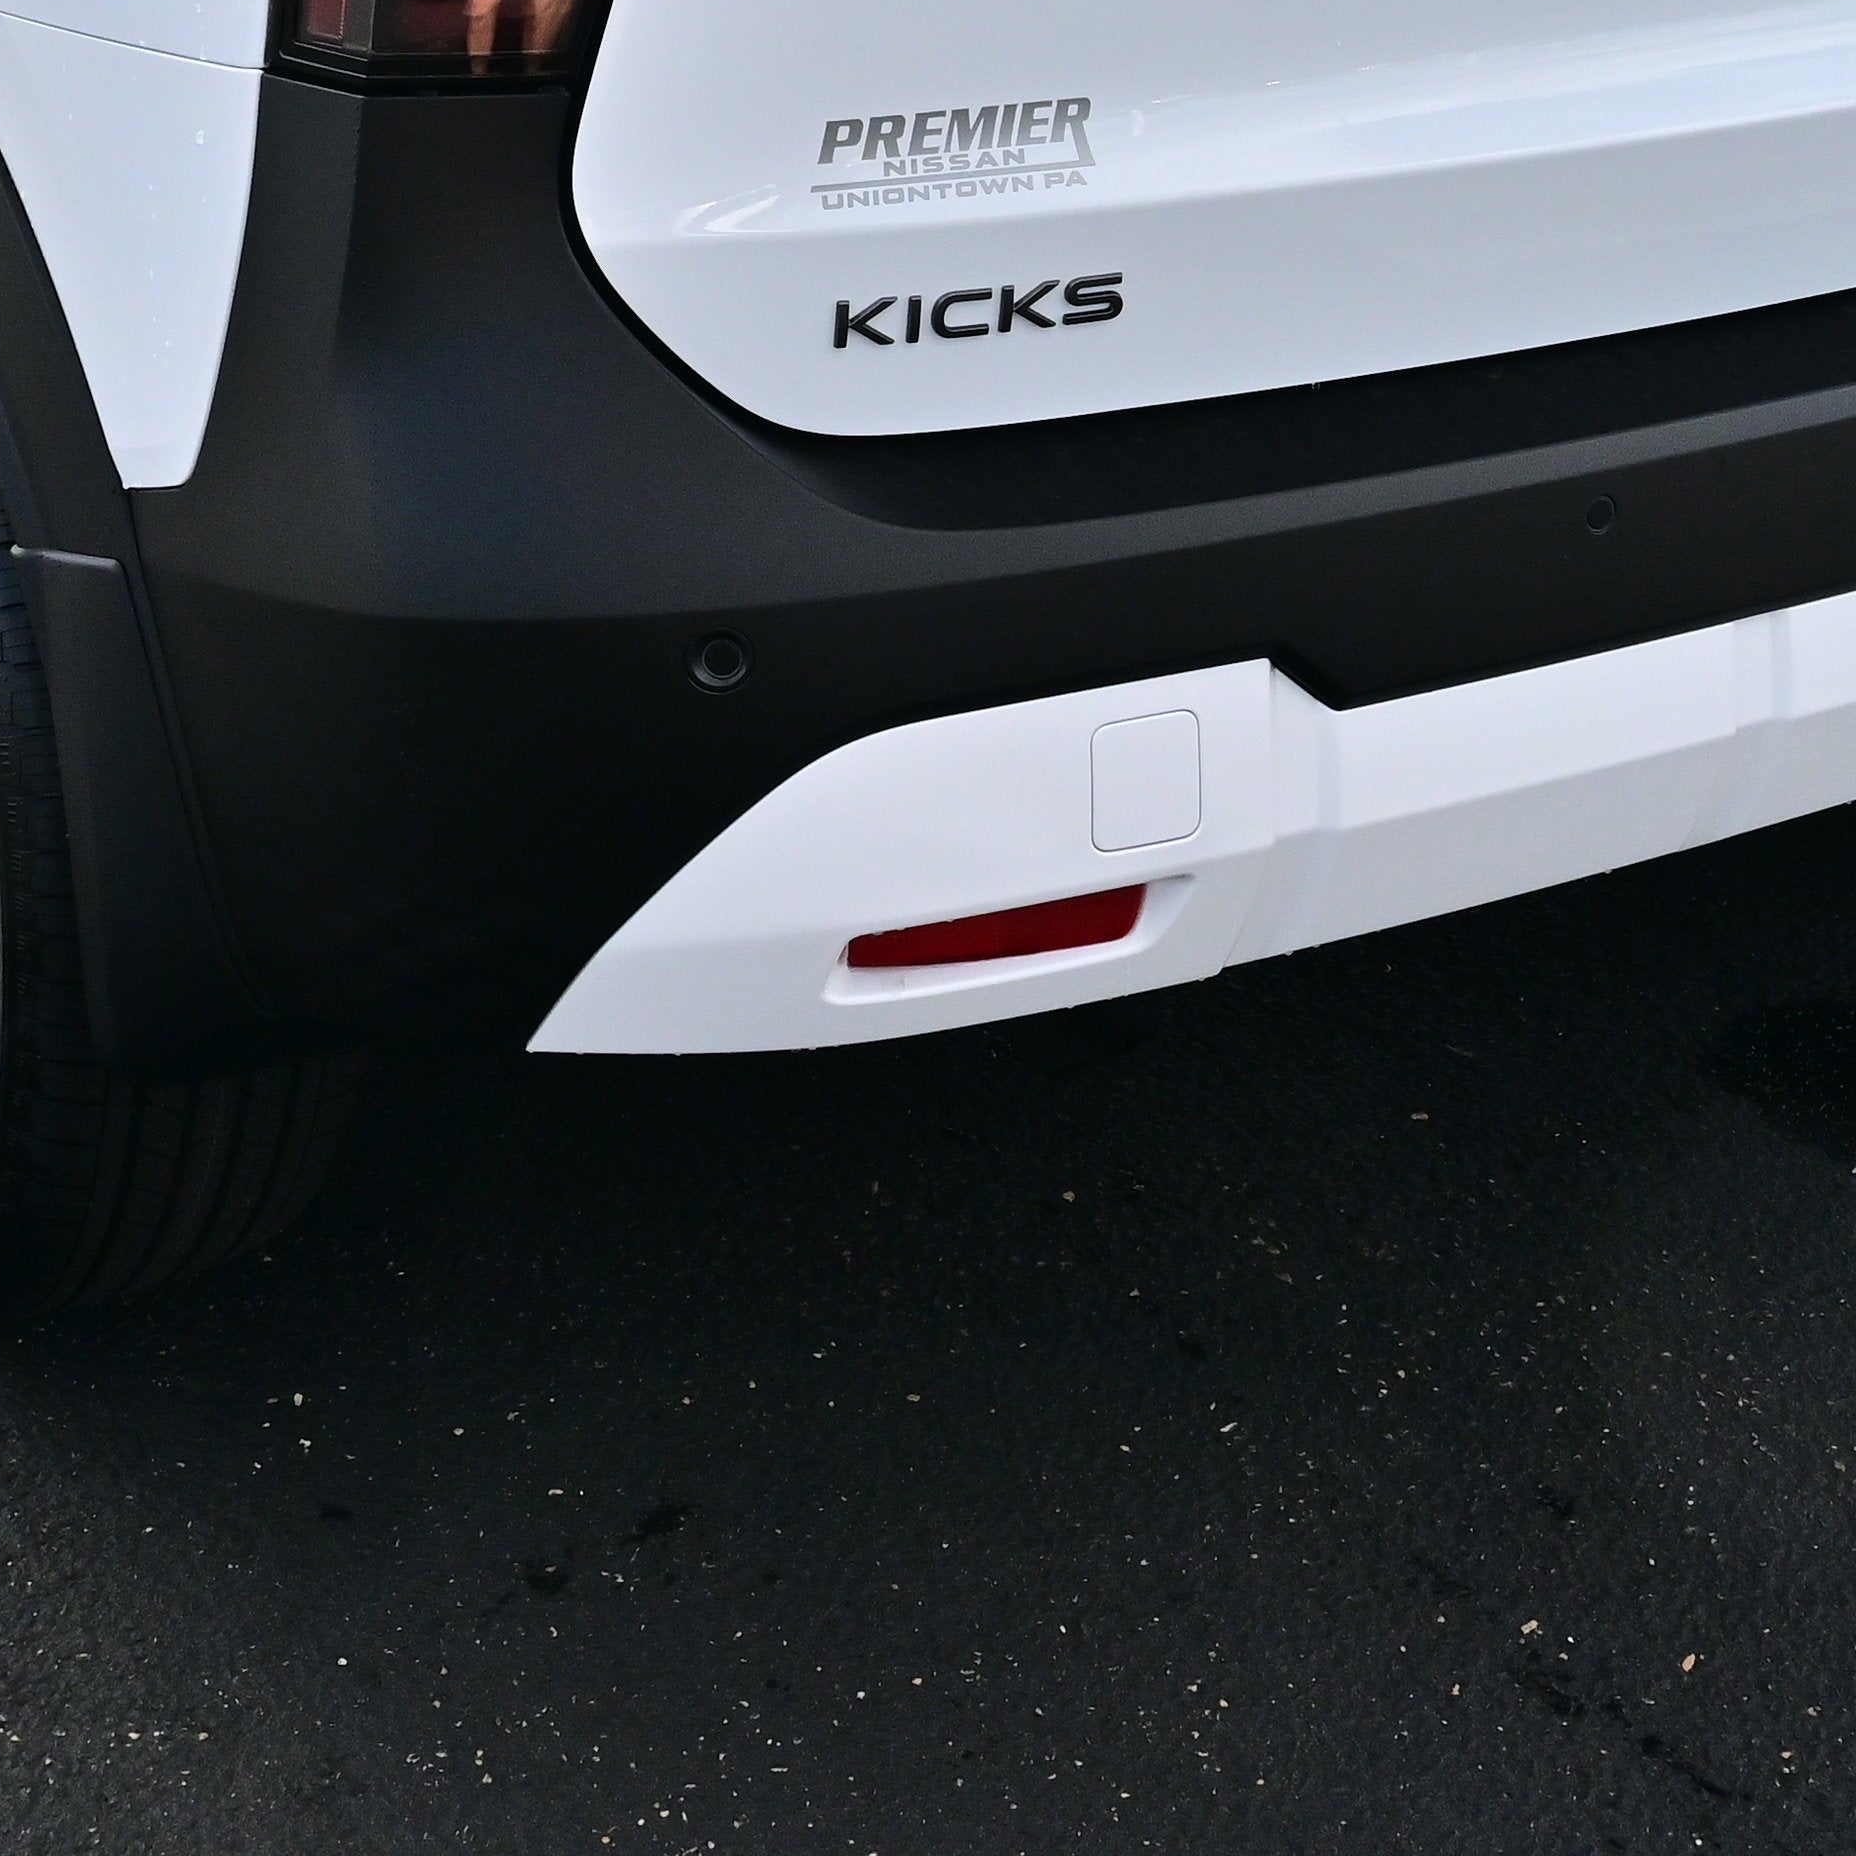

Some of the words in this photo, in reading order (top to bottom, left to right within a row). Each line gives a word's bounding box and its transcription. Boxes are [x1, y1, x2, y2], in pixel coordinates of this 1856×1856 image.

[816, 96, 1096, 167] PREMIER
[821, 174, 1034, 211] UNIONTOWN
[1044, 170, 1088, 190] PA
[883, 148, 1026, 178] NISSAN
[833, 271, 1124, 349] KICKS
